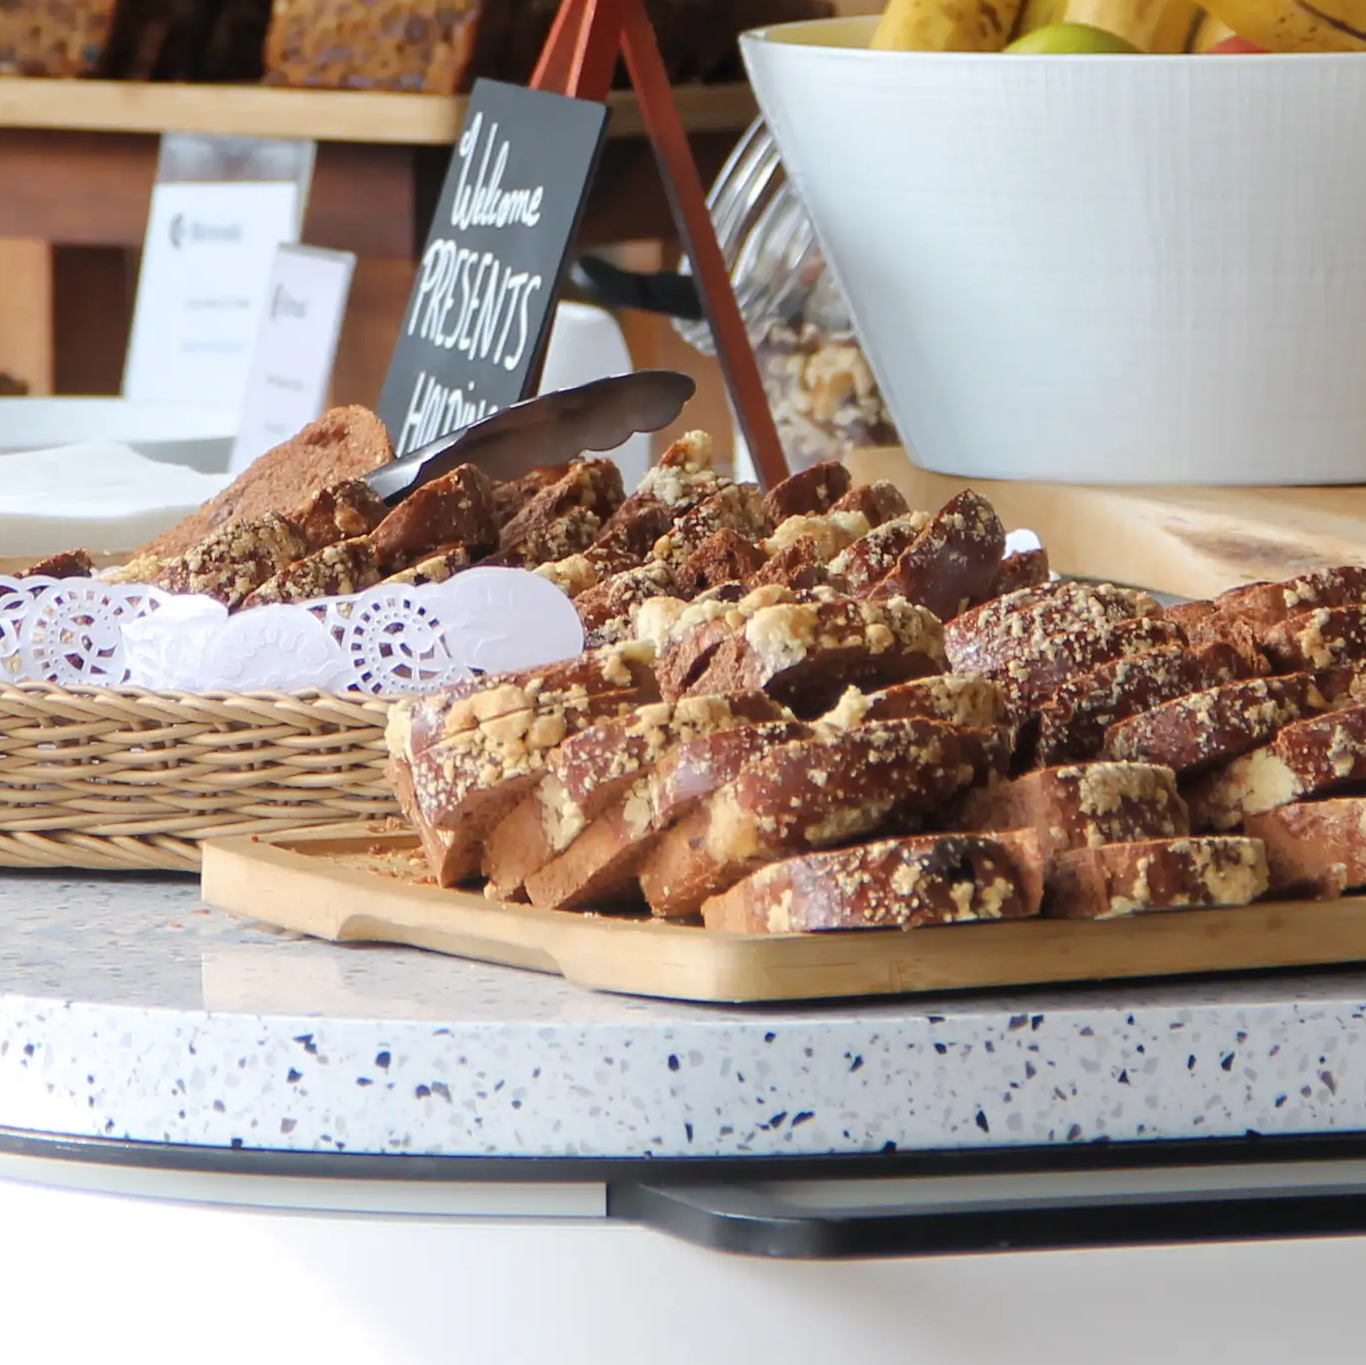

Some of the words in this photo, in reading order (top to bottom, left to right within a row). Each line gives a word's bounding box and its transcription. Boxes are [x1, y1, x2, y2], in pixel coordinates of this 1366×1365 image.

[450, 110, 544, 231] Welcome
[407, 237, 542, 372] PRESENTS
[395, 370, 499, 459] HOLD
